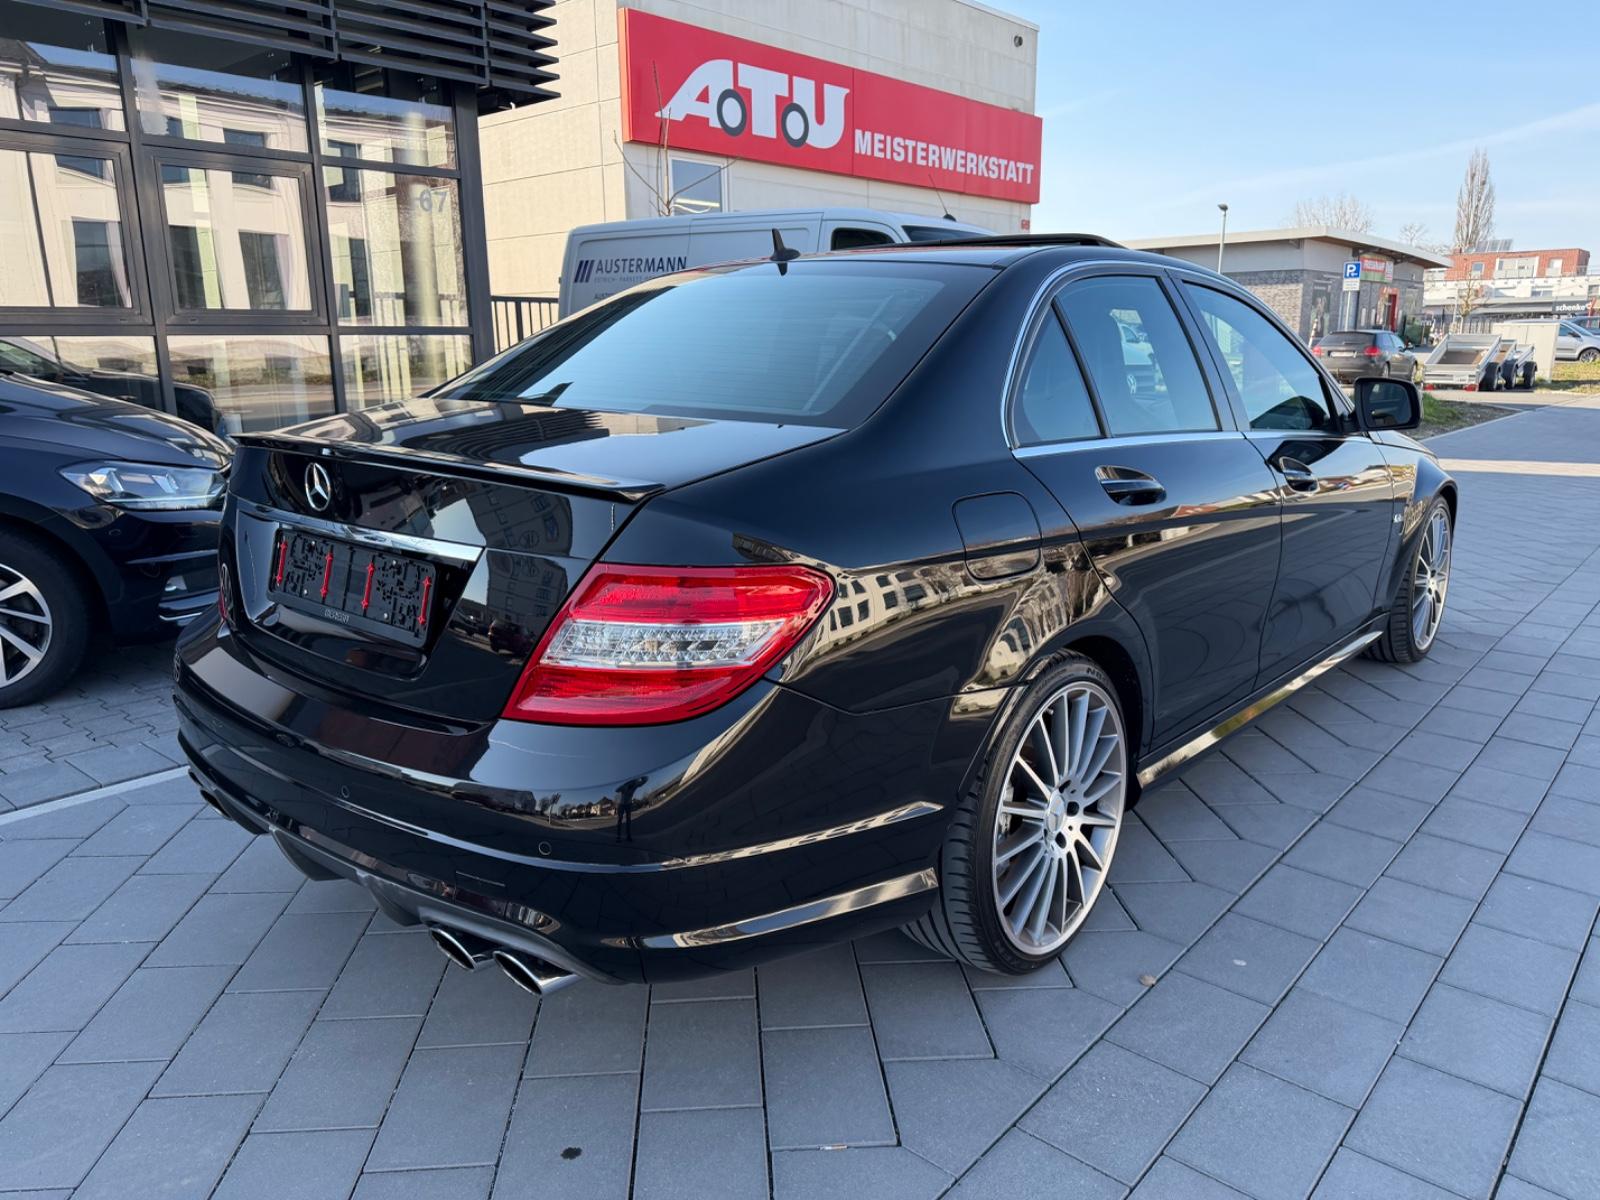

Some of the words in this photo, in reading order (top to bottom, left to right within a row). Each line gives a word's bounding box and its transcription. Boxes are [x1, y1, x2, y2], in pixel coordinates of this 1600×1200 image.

[854, 128, 1034, 185] MEISTERWERKSTATT
[420, 189, 447, 212] 67
[595, 256, 687, 274] AUSTERMANN
[1346, 264, 1357, 277] P
